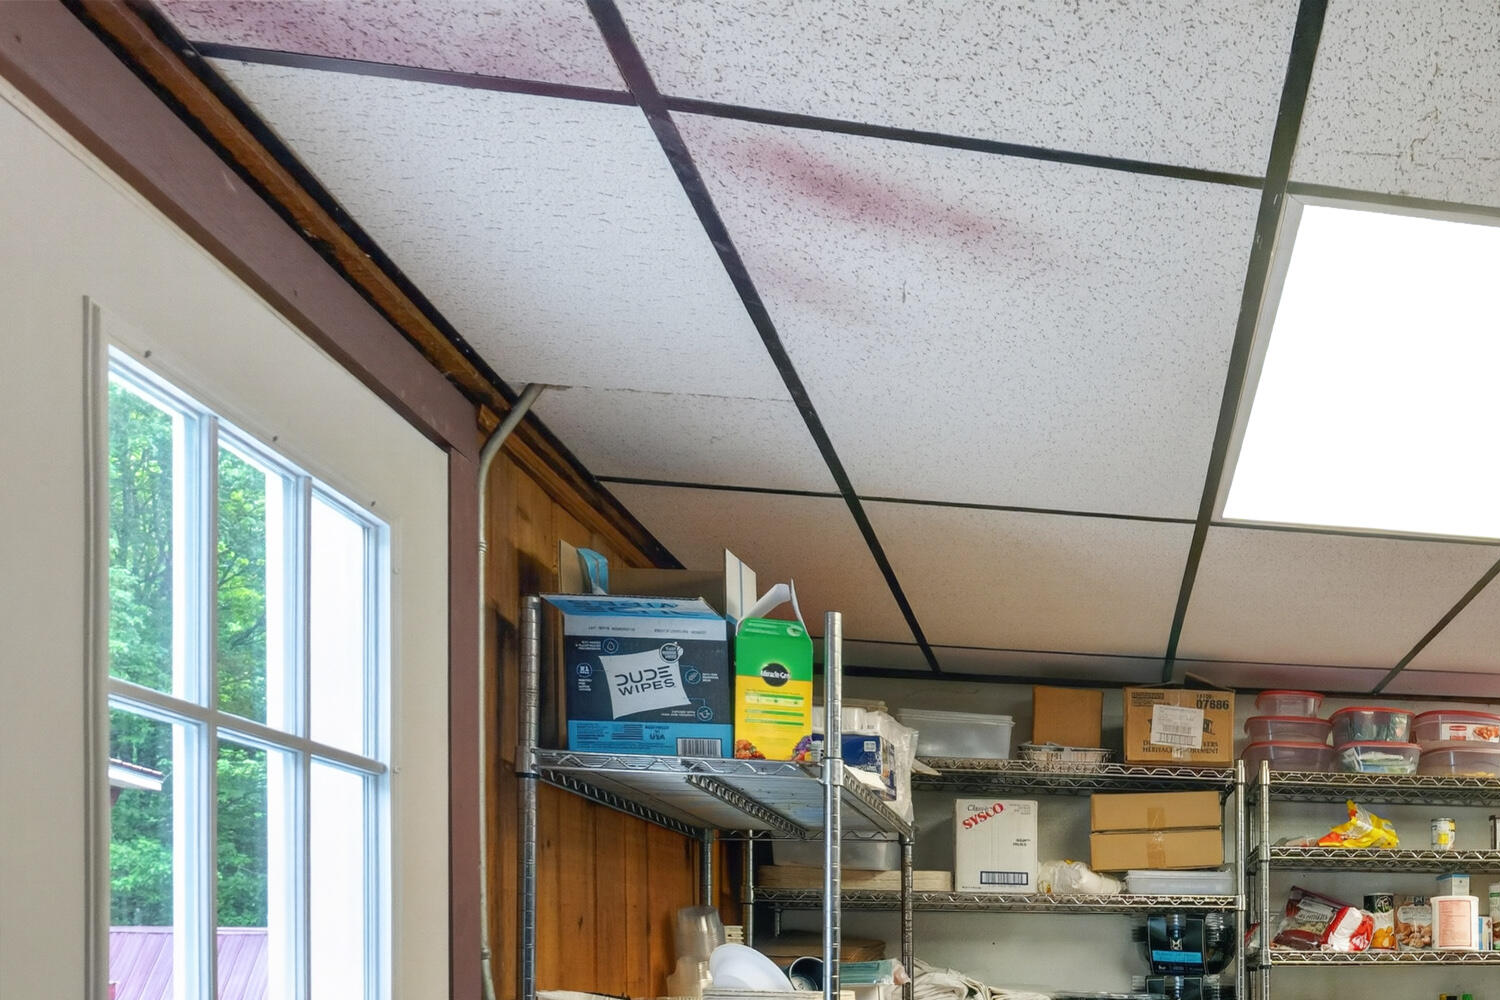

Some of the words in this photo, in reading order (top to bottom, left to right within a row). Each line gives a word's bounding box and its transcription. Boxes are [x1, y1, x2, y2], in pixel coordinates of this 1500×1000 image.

[614, 665, 673, 687] DUDE
[617, 678, 676, 697] WIPES
[962, 803, 1004, 830] SYSCO
